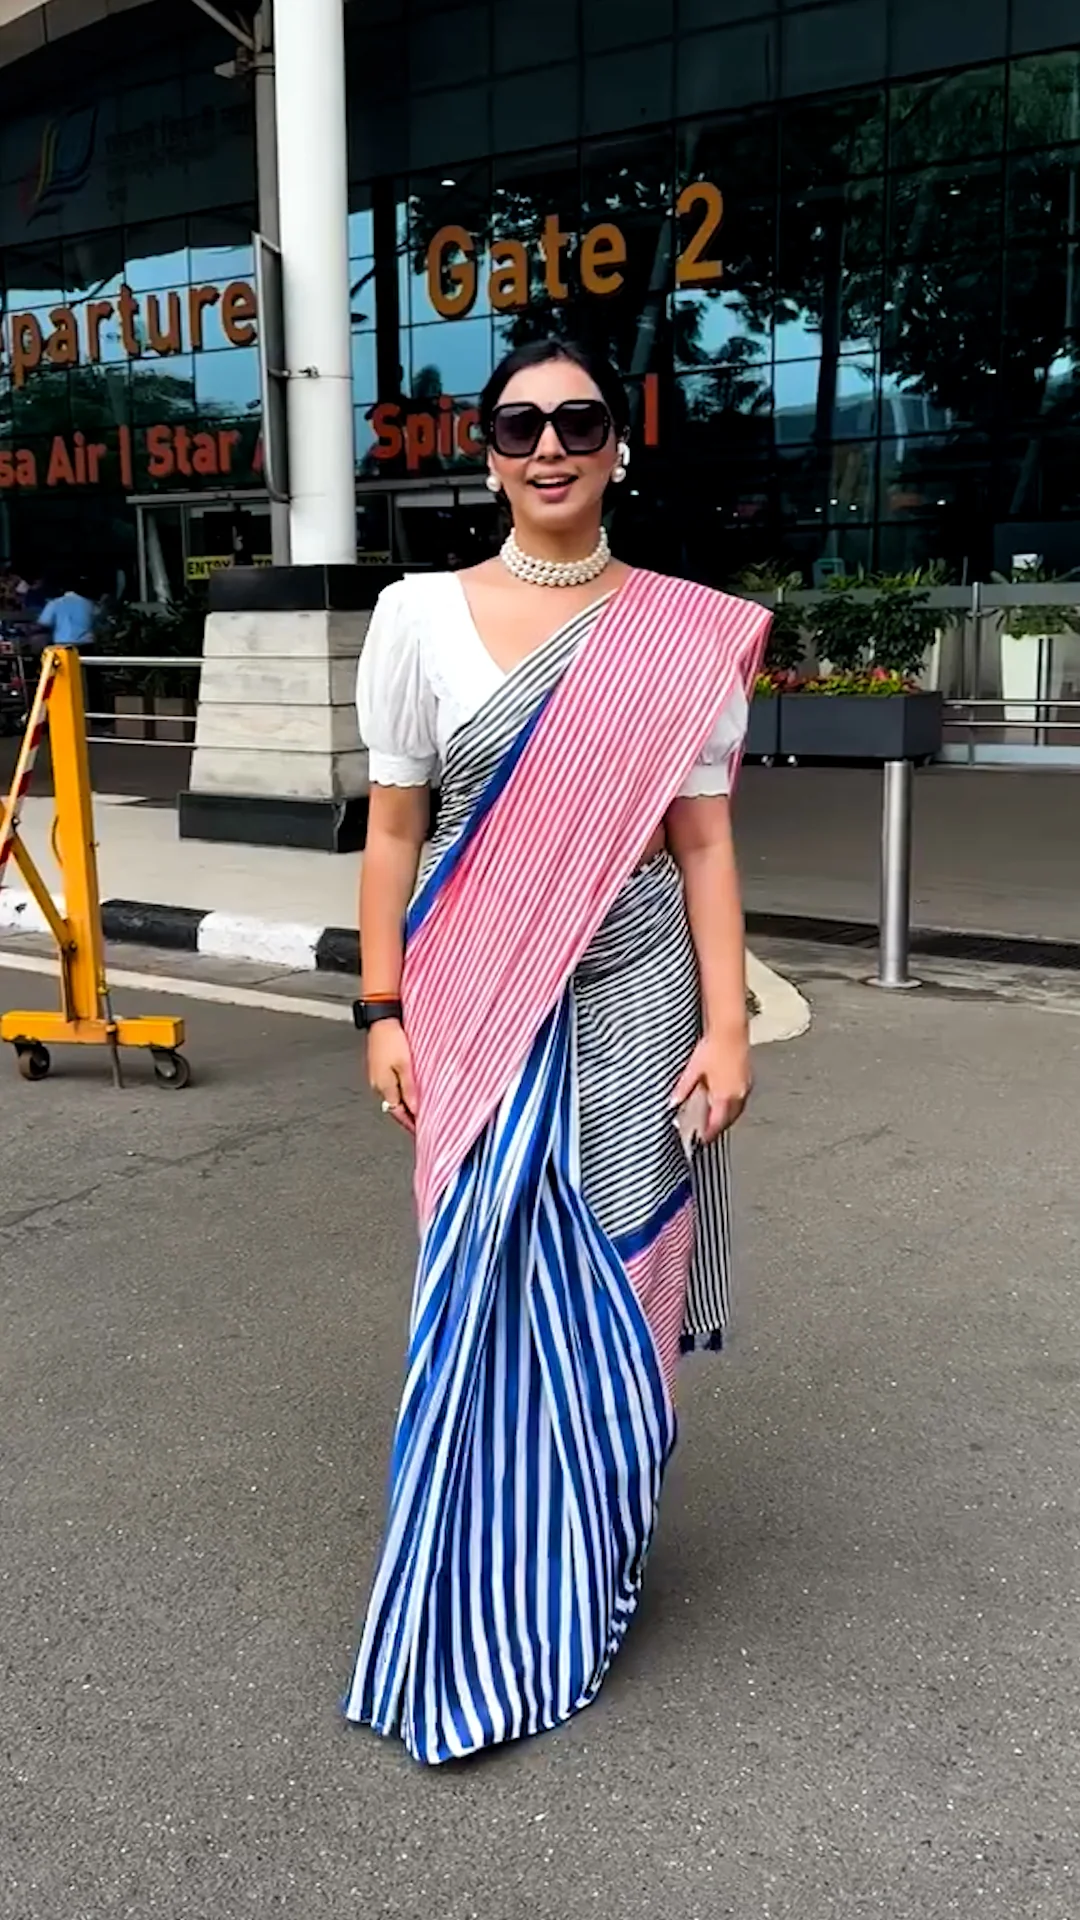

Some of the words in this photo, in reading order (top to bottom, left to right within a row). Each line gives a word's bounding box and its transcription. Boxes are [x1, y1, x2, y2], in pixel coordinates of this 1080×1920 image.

[426, 214, 627, 320] Gate
[676, 182, 724, 288] 2
[0, 281, 258, 390] parture
[47, 431, 107, 488] Air
[146, 424, 241, 479] Star
[369, 394, 483, 471] Spic
